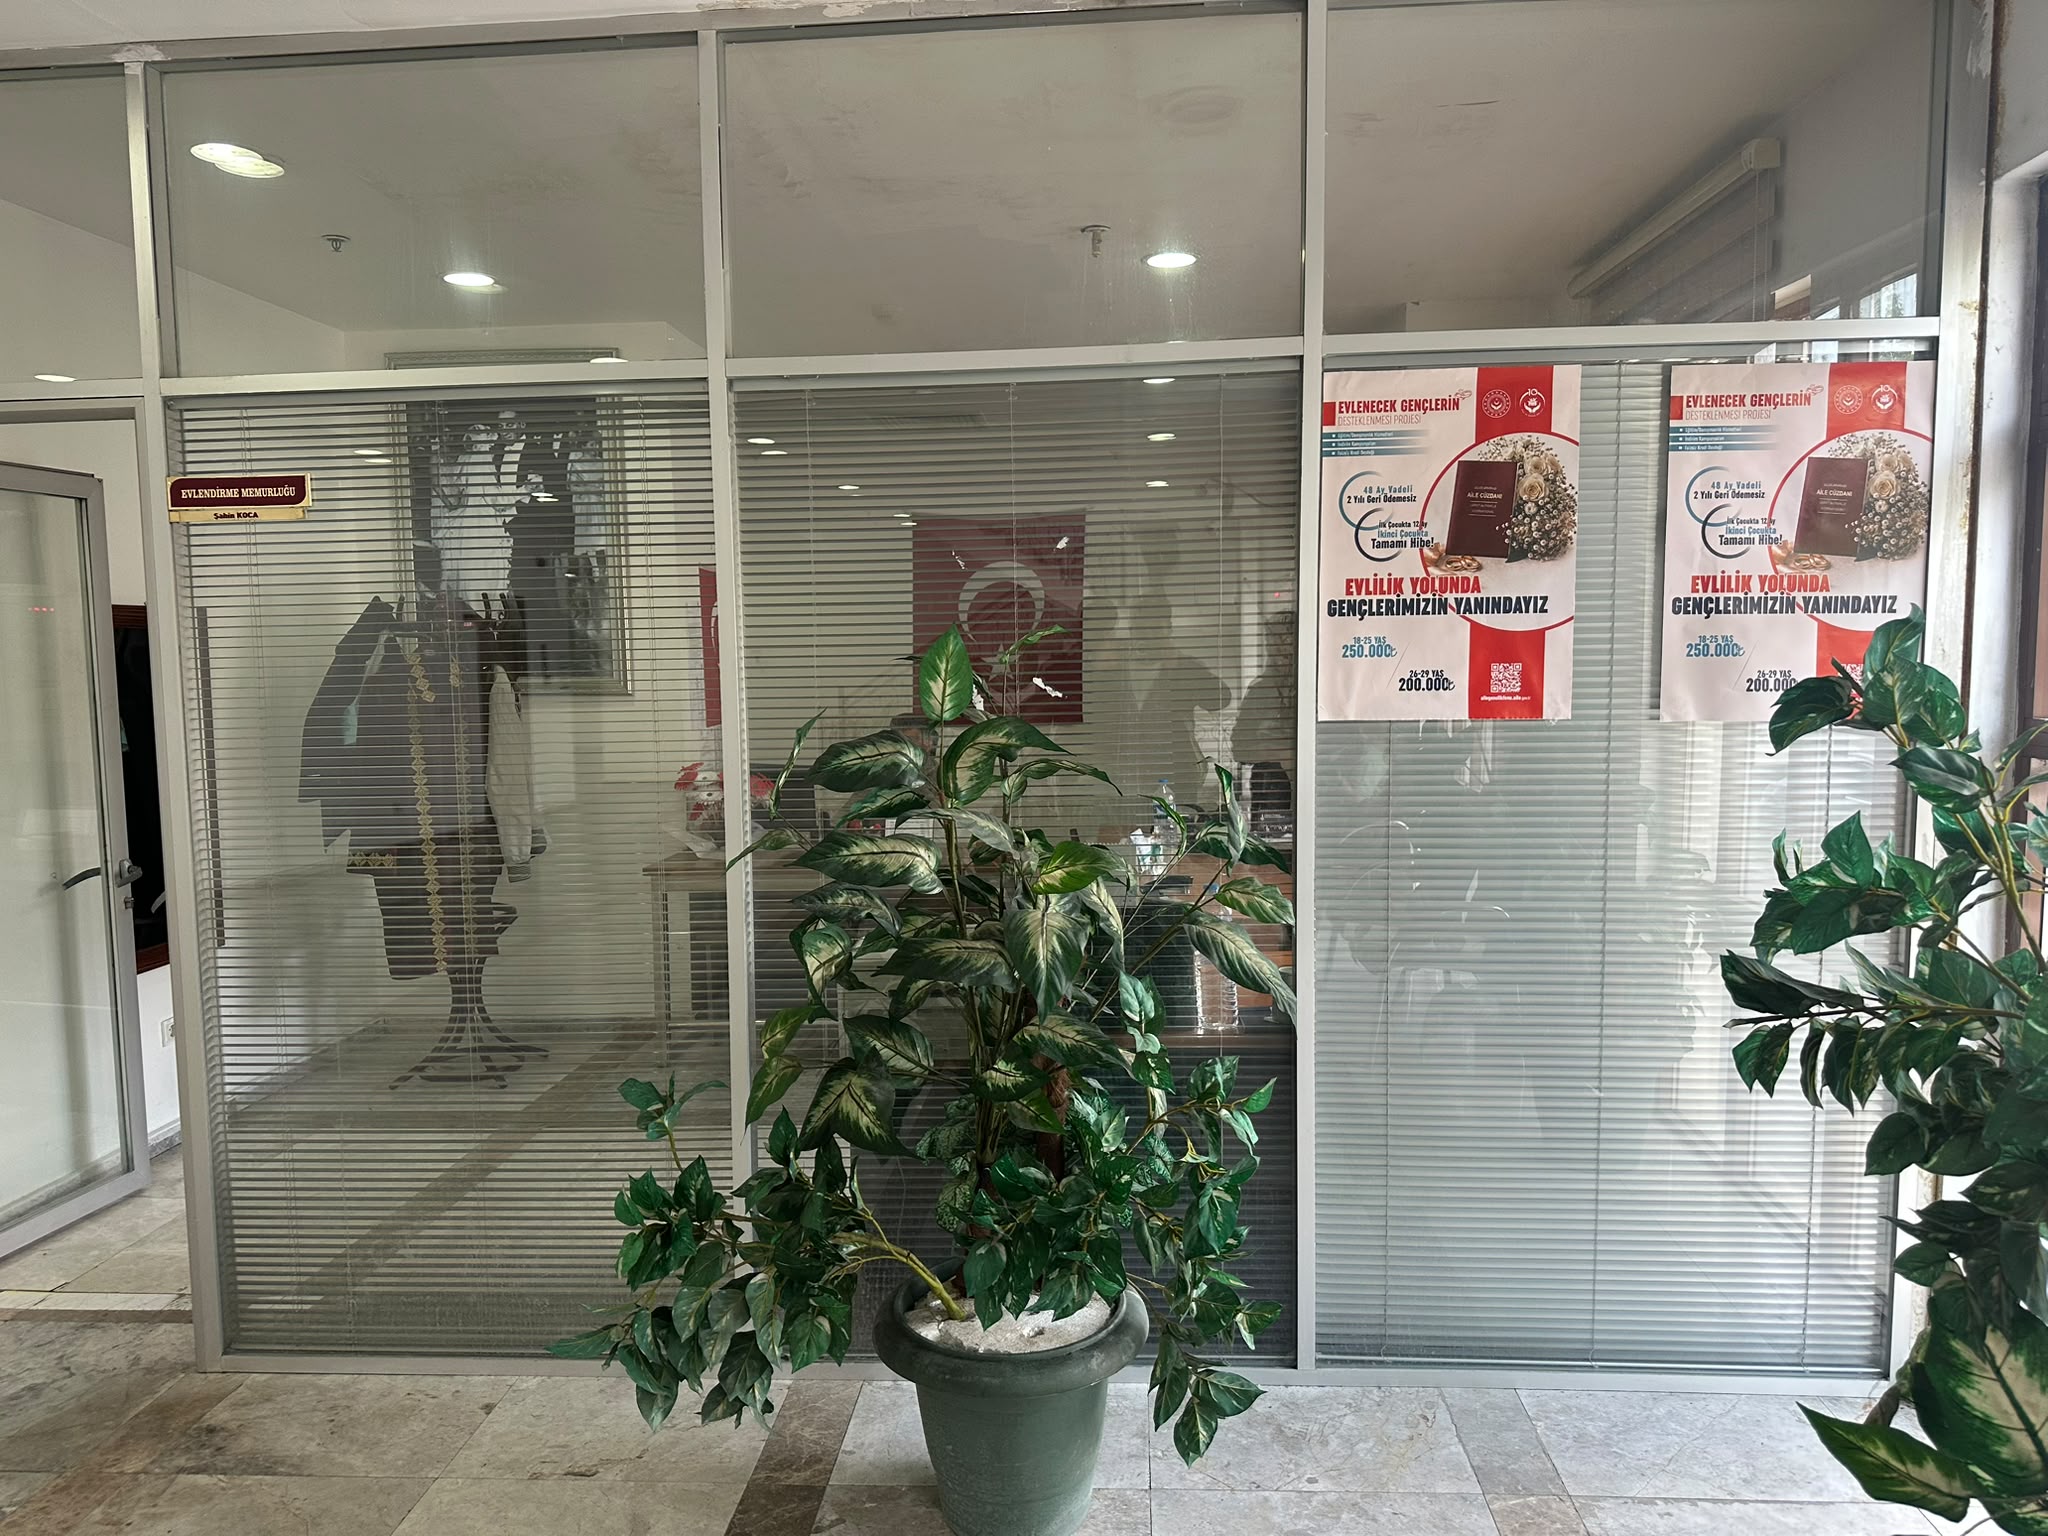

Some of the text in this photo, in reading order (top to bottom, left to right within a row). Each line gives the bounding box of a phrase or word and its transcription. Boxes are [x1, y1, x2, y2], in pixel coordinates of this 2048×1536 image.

[1338, 394, 1460, 415] EVLENECEK GENÇLERİN
[1686, 390, 1811, 409] EVLENECEK GENÇLERİN
[181, 484, 296, 499] EVLENDİRME MEMURLUĞU
[1376, 486, 1385, 495] Ay
[1388, 485, 1413, 494] Vadeli
[1724, 482, 1734, 491] Ay
[1737, 481, 1761, 489] Vadeli
[1347, 492, 1417, 504] 2 Yılı Geri Ödemesiz
[1700, 490, 1712, 499] Yılı
[1714, 490, 1730, 499] Geri
[1388, 521, 1411, 529] Çocukta
[1725, 525, 1776, 536] İkinci Çocukta
[1378, 529, 1428, 539] İkinci Çocukta
[1718, 534, 1783, 545] Tamamı Hibe!
[1371, 537, 1434, 549] Tamamı Hibe!
[1345, 572, 1482, 596] EVLİLİK YOLUNDA
[1690, 570, 1830, 593] EVLİLİK YOLUNDA
[1327, 593, 1549, 621] GENÇLERİMİZİN YANINDAYIZ
[1672, 591, 1897, 619] GENÇLERİMİZİN YANINDAYIZ
[1374, 636, 1387, 646] YAŞ
[1721, 635, 1734, 644] YAŞ
[1409, 670, 1444, 679] 26-29 YAŞ
[1757, 670, 1792, 680] 26-29 YAŞ
[1746, 678, 1798, 692] 200.000
